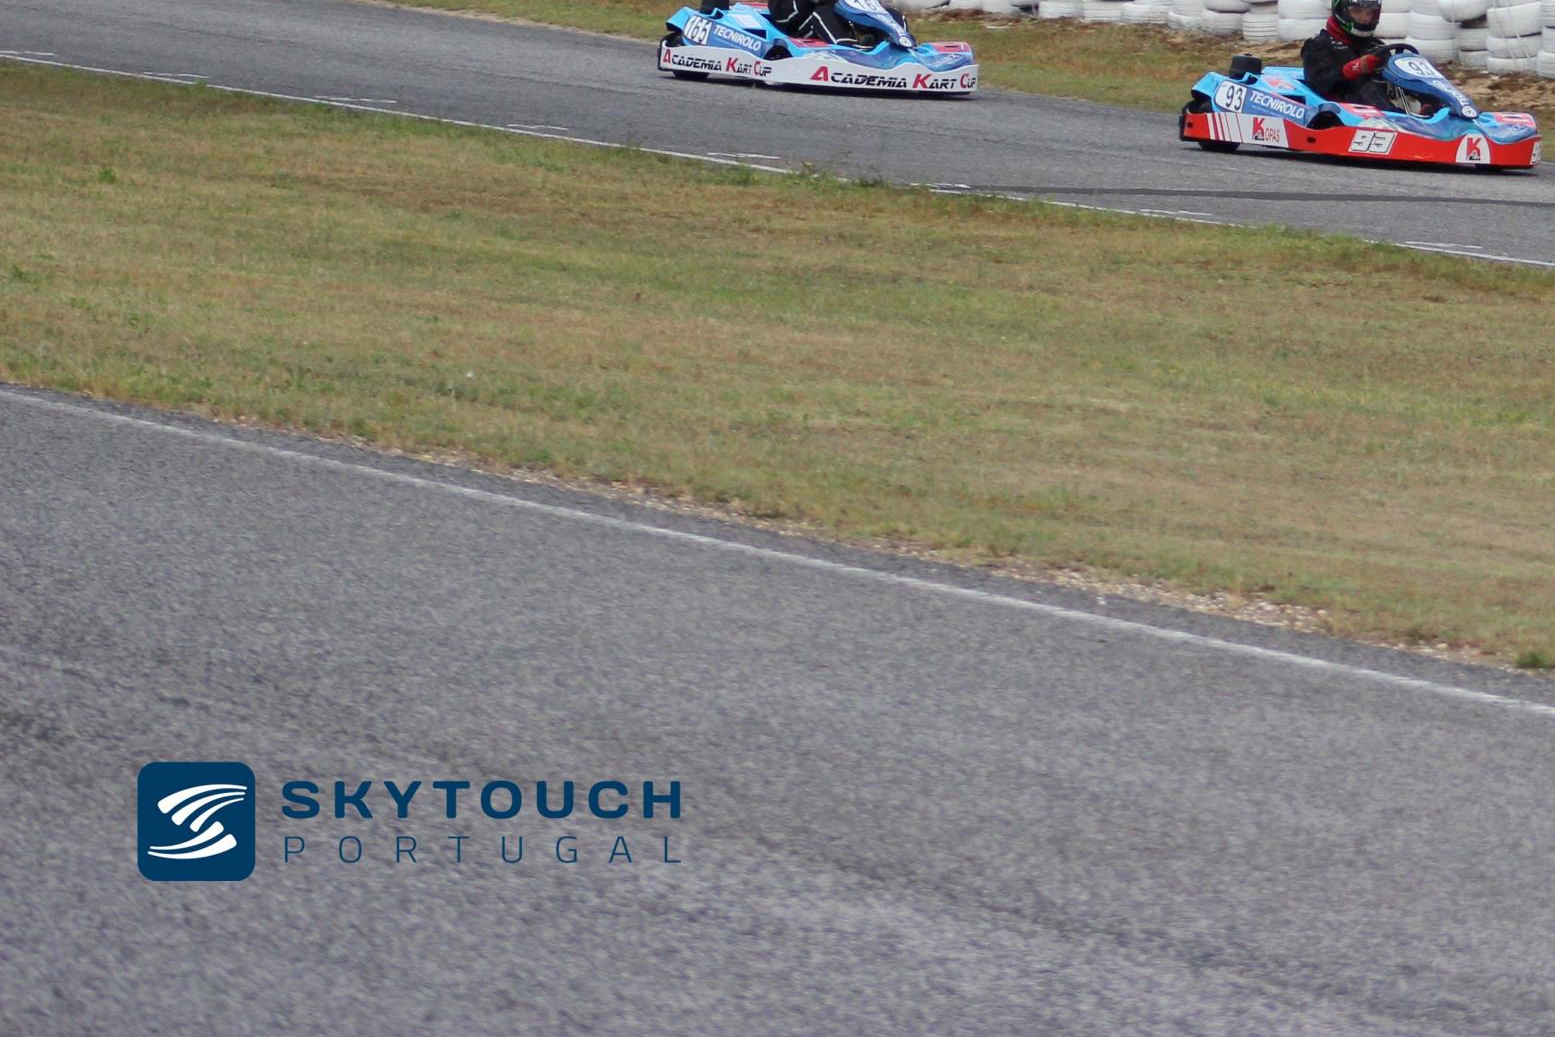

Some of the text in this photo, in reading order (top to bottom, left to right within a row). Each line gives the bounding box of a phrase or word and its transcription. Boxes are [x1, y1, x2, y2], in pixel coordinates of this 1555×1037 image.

[714, 24, 762, 51] TECNIROLO
[1408, 61, 1435, 77] 93
[1225, 84, 1243, 111] 93
[1249, 89, 1305, 119] TECNIROLO
